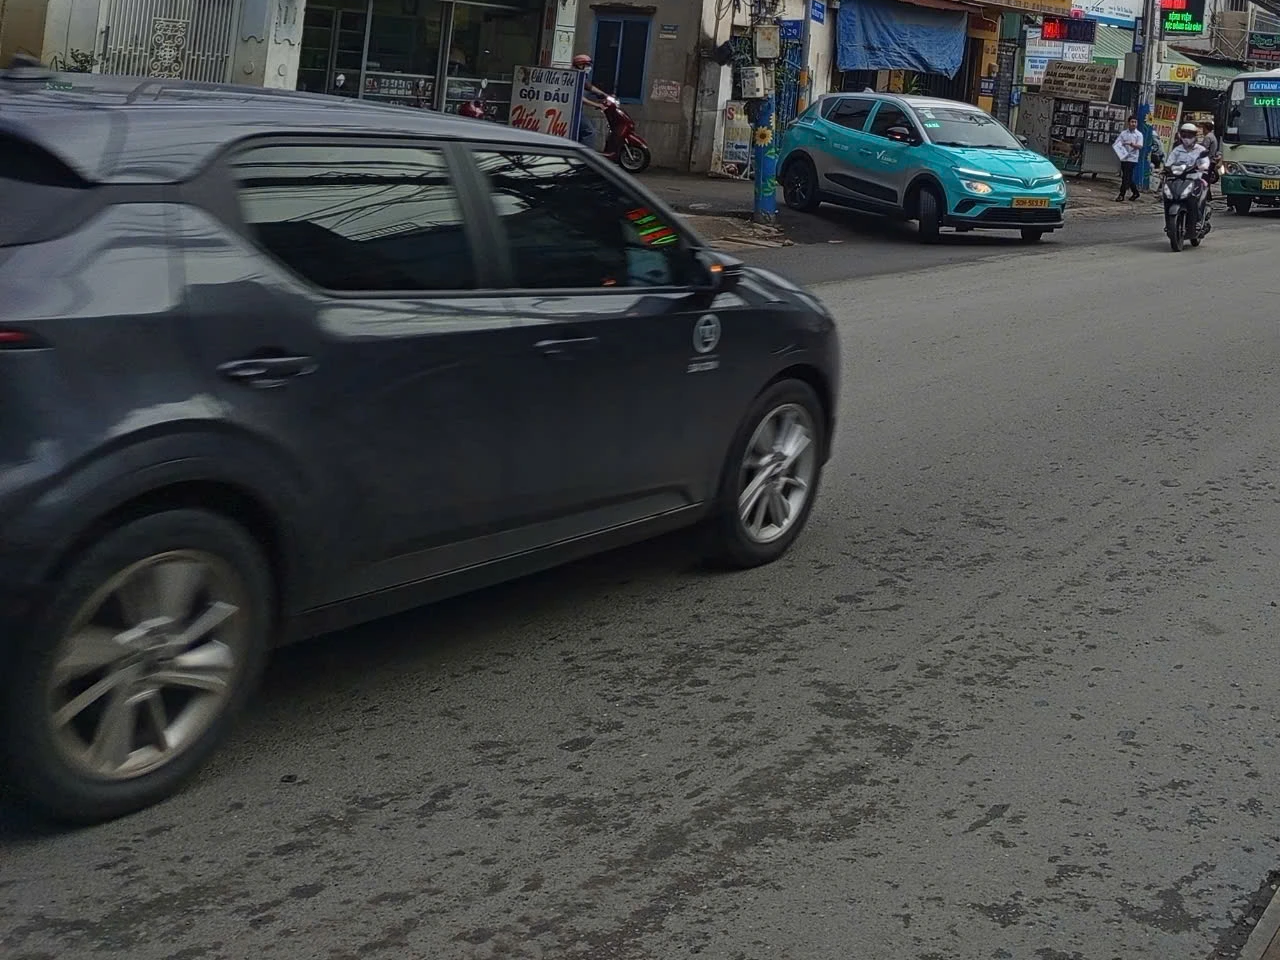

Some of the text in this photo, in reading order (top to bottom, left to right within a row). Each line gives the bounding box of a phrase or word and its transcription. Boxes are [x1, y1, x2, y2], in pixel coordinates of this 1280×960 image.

[520, 86, 540, 101] GỘI
[1253, 97, 1276, 108] Lượt
[545, 108, 568, 137] Thu
